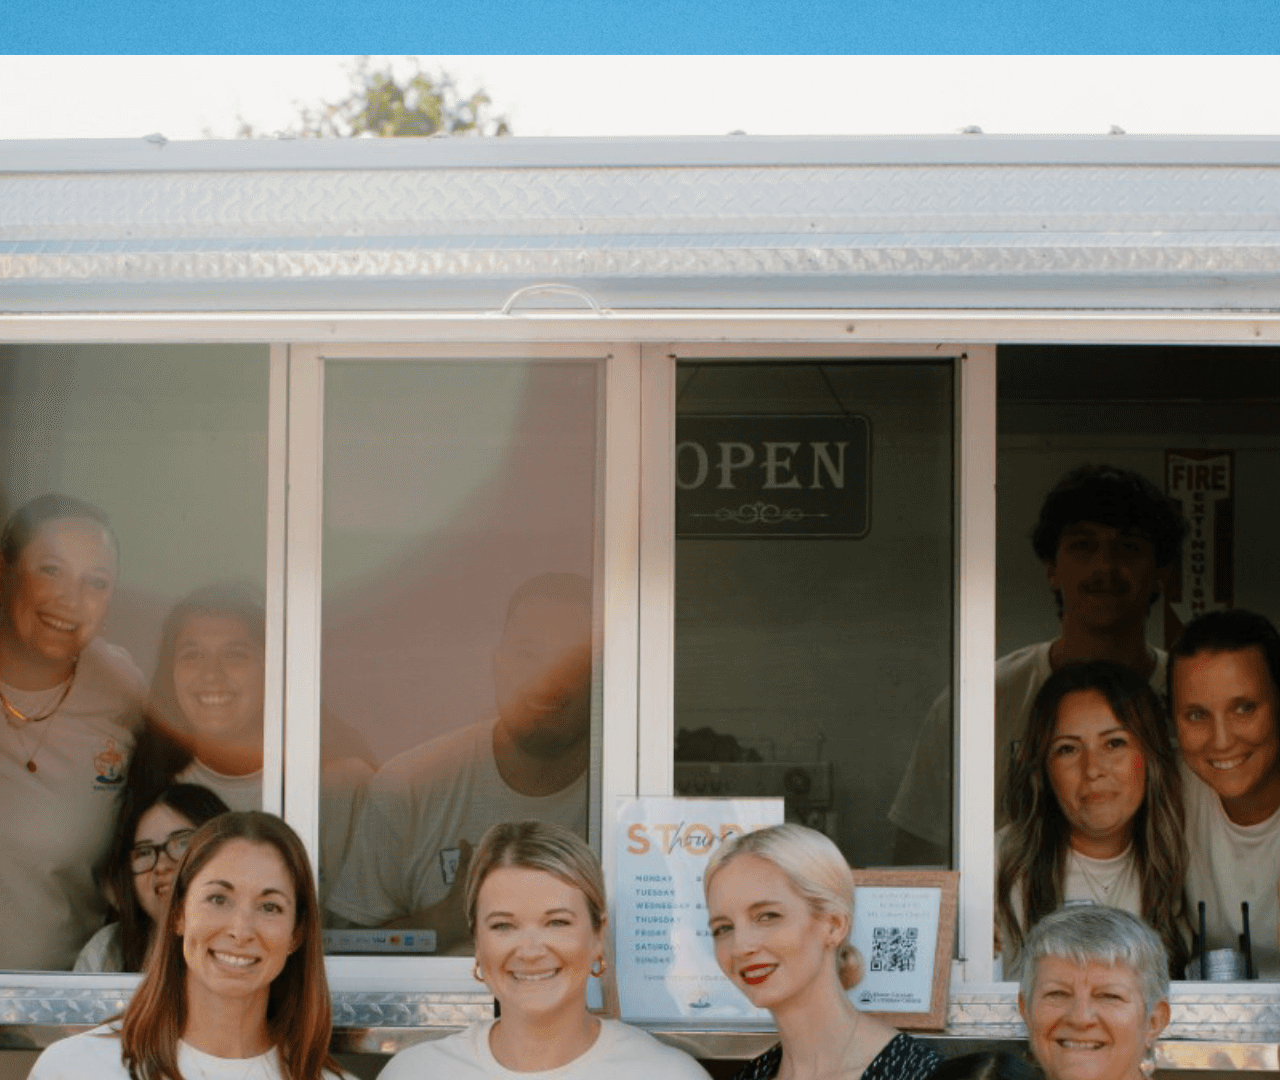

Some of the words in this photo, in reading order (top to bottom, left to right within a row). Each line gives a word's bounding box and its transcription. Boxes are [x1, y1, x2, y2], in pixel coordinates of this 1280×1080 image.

[676, 441, 850, 490] OPEN
[1172, 464, 1226, 490] FIRE
[1191, 492, 1206, 611] EXTINGUISH
